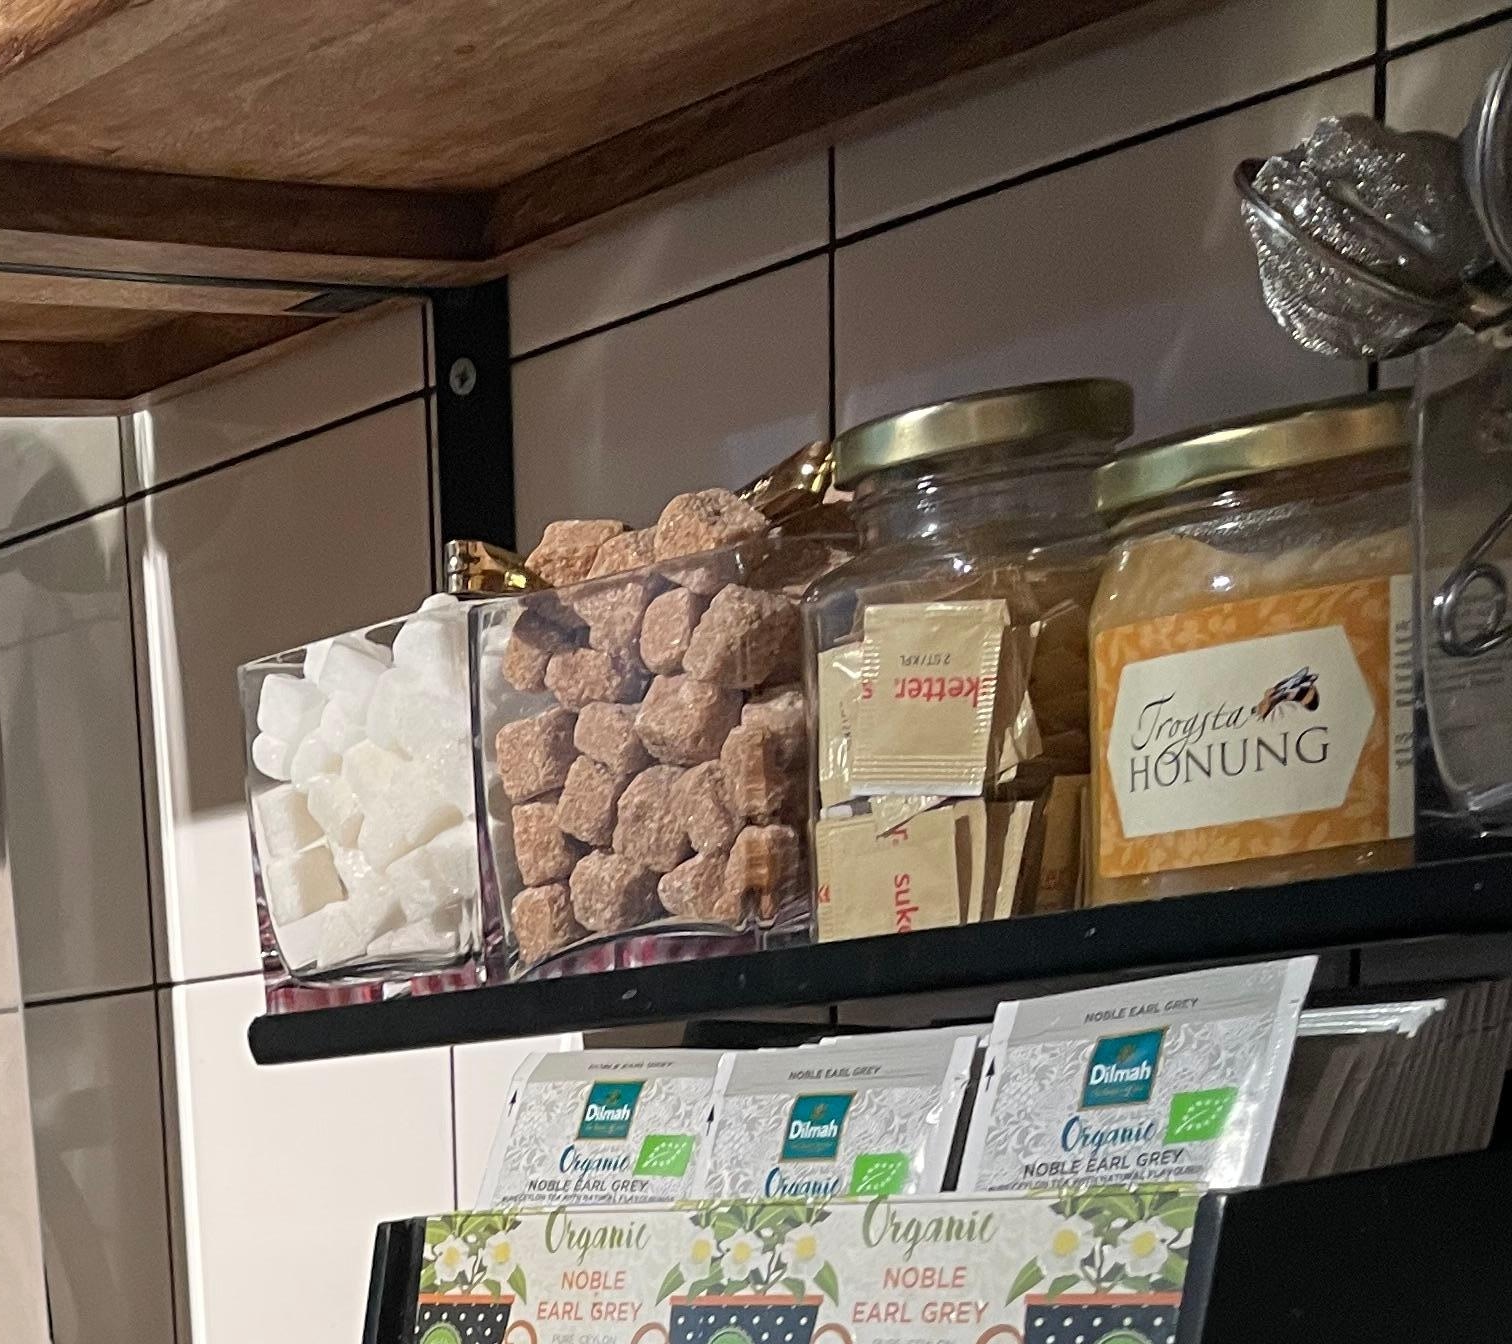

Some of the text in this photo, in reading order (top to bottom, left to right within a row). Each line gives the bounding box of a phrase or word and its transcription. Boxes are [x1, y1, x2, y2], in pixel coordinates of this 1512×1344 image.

[1085, 998, 1198, 1023] NOBLE EARL GREY
[789, 1065, 881, 1080] NOBLE EARL GREY
[1090, 1060, 1152, 1085] Dilmah
[585, 1104, 630, 1121] Dilmah
[789, 1119, 838, 1140] Dilmah
[1062, 1115, 1156, 1154] Organic
[560, 1145, 630, 1180] Organic
[1024, 1158, 1080, 1178] NOBLE
[1088, 1154, 1129, 1171] EARL
[1138, 1149, 1184, 1166] GREY
[528, 1179, 648, 1192] NOBLE EARL GREY
[545, 1205, 651, 1266] Organic
[863, 1194, 998, 1262] Organic
[561, 1270, 626, 1290] NOBLE
[883, 1266, 967, 1290] NOBLE
[537, 1302, 642, 1322] EARL GREY
[852, 1302, 988, 1323] EARL GREY
